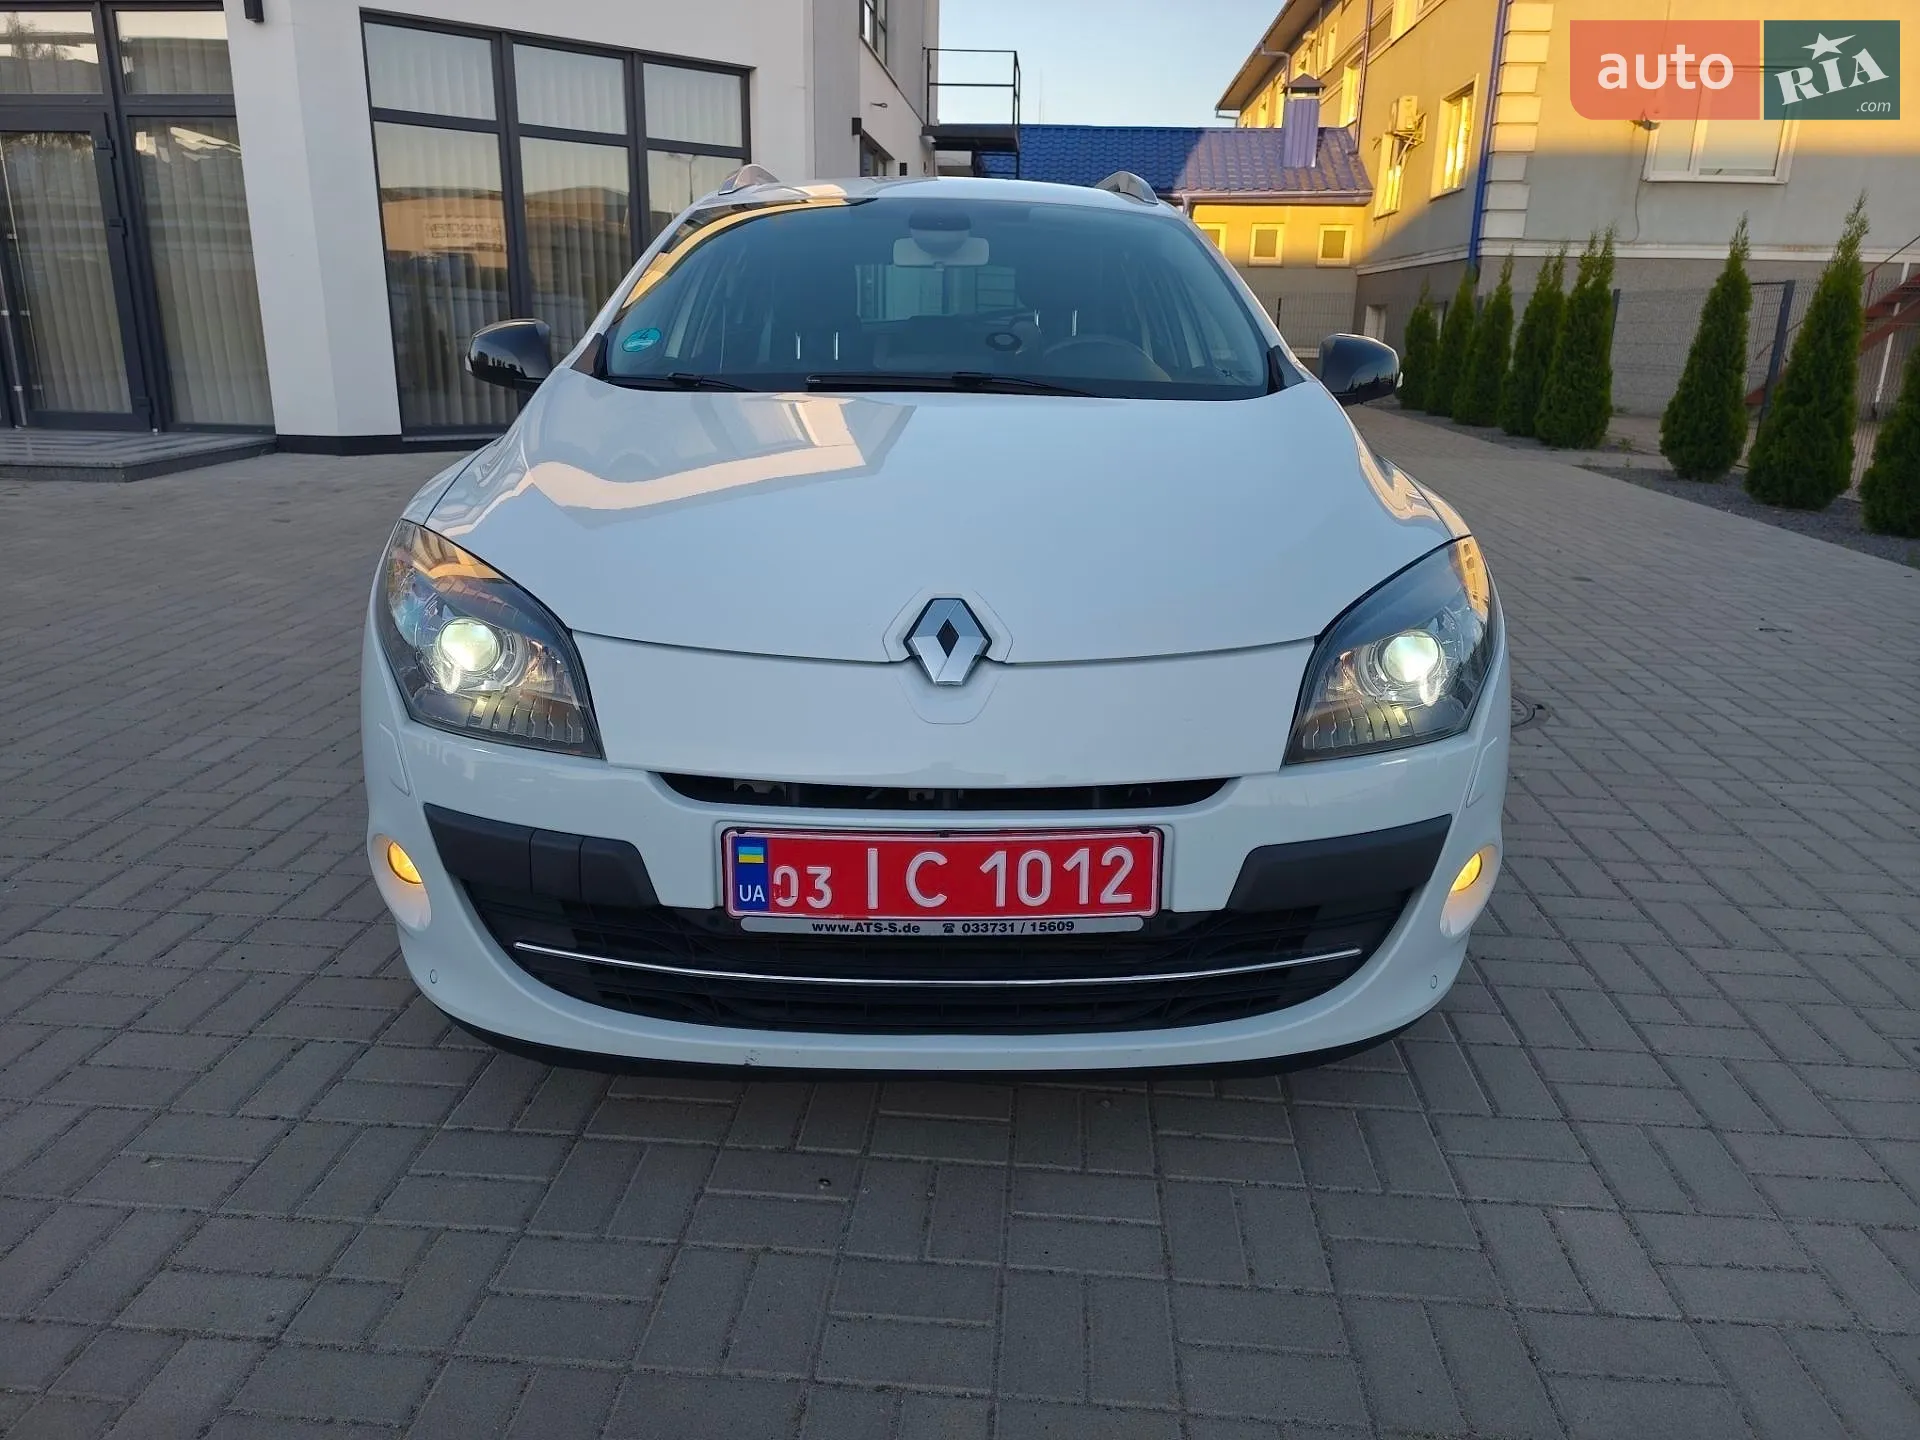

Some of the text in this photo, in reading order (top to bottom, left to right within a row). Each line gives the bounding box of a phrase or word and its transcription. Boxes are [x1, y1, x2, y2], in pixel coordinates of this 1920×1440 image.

[773, 865, 833, 909] 03
[979, 845, 1135, 908] 1012
[739, 884, 766, 903] UA
[811, 922, 921, 934] www.ATS-S.de
[961, 922, 1015, 933] 033731
[1030, 921, 1075, 932] 15609
